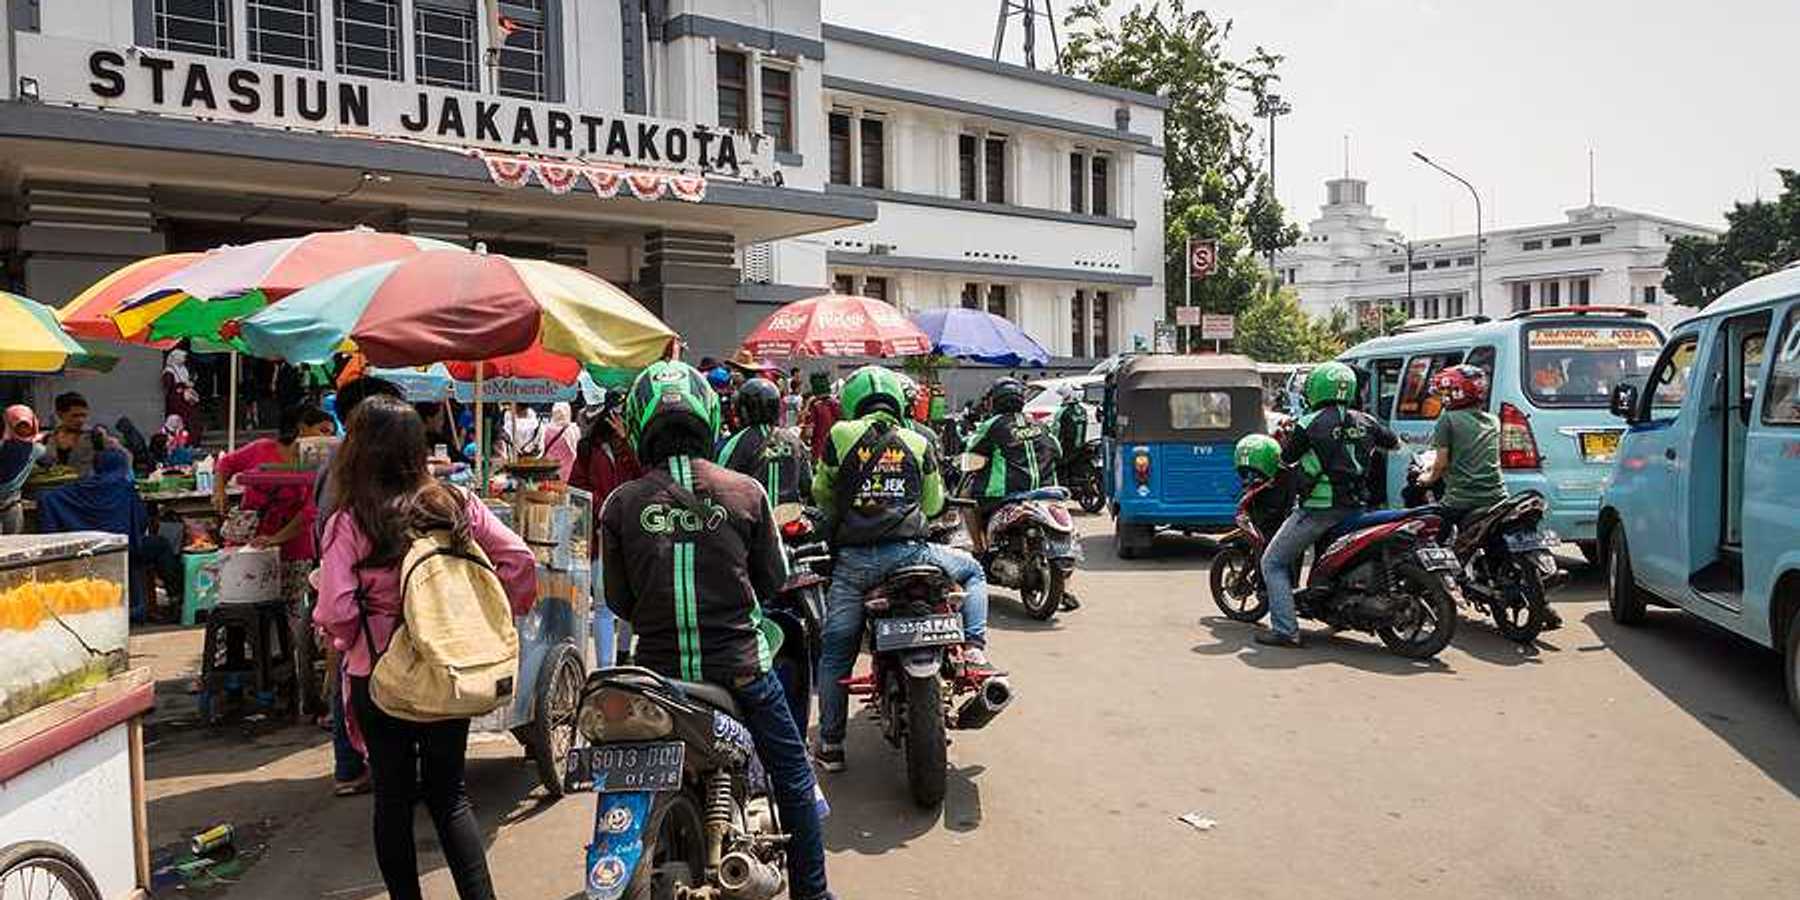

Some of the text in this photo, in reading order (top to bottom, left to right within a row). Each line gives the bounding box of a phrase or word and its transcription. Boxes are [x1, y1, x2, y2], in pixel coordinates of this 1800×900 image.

[88, 50, 740, 172] STASIUN JAKARTAKOTA
[640, 497, 727, 533] Grab
